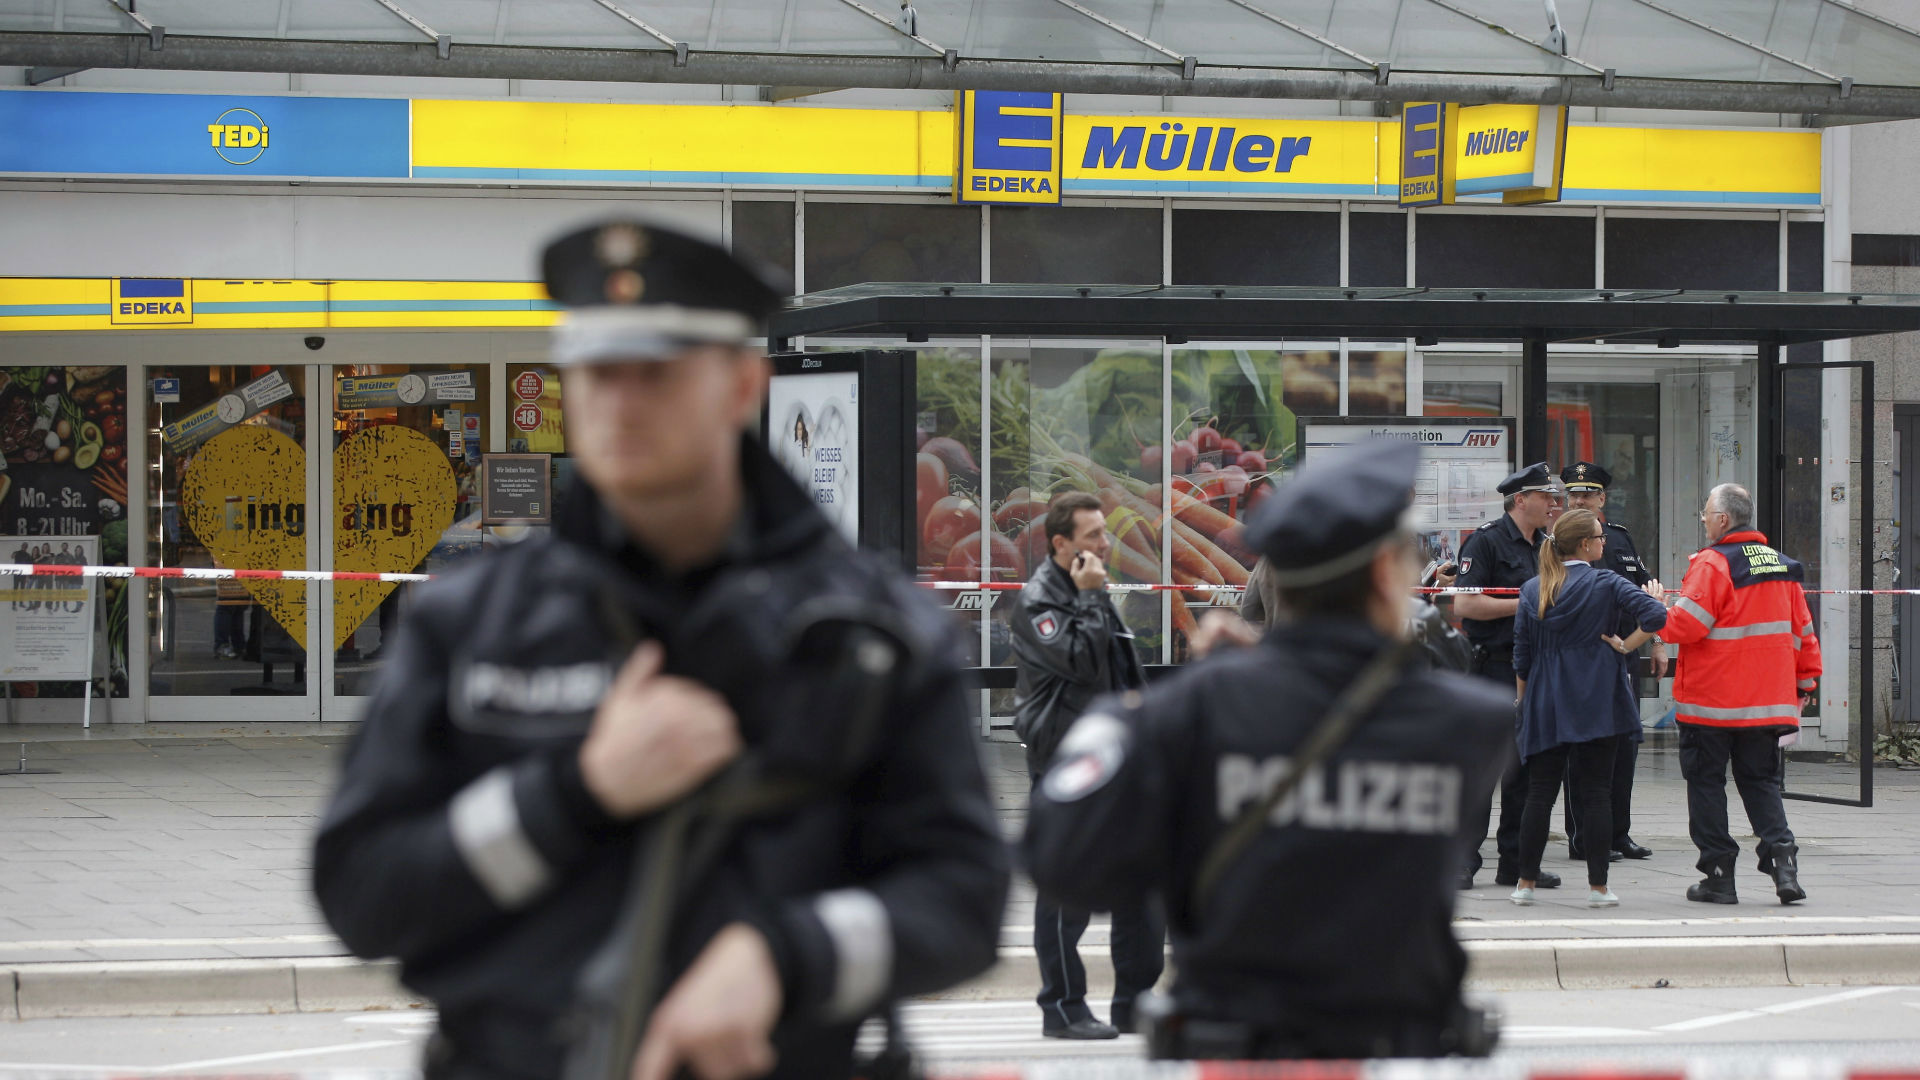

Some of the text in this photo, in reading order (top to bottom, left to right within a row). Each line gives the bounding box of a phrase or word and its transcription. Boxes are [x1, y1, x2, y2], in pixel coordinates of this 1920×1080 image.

[207, 124, 269, 149] TEDi
[1464, 126, 1530, 157] Müller
[1081, 121, 1311, 174] Müller
[971, 176, 1053, 195] EDEKA
[1402, 181, 1436, 198] EDEKA
[119, 302, 186, 315] EDEKA
[1467, 434, 1501, 447] HVV
[814, 448, 842, 462] WEISSES
[814, 468, 836, 483] BLEIBT
[813, 488, 834, 503] WEISS
[60, 517, 91, 535] Uhr
[1215, 753, 1463, 836] POLIZEI
